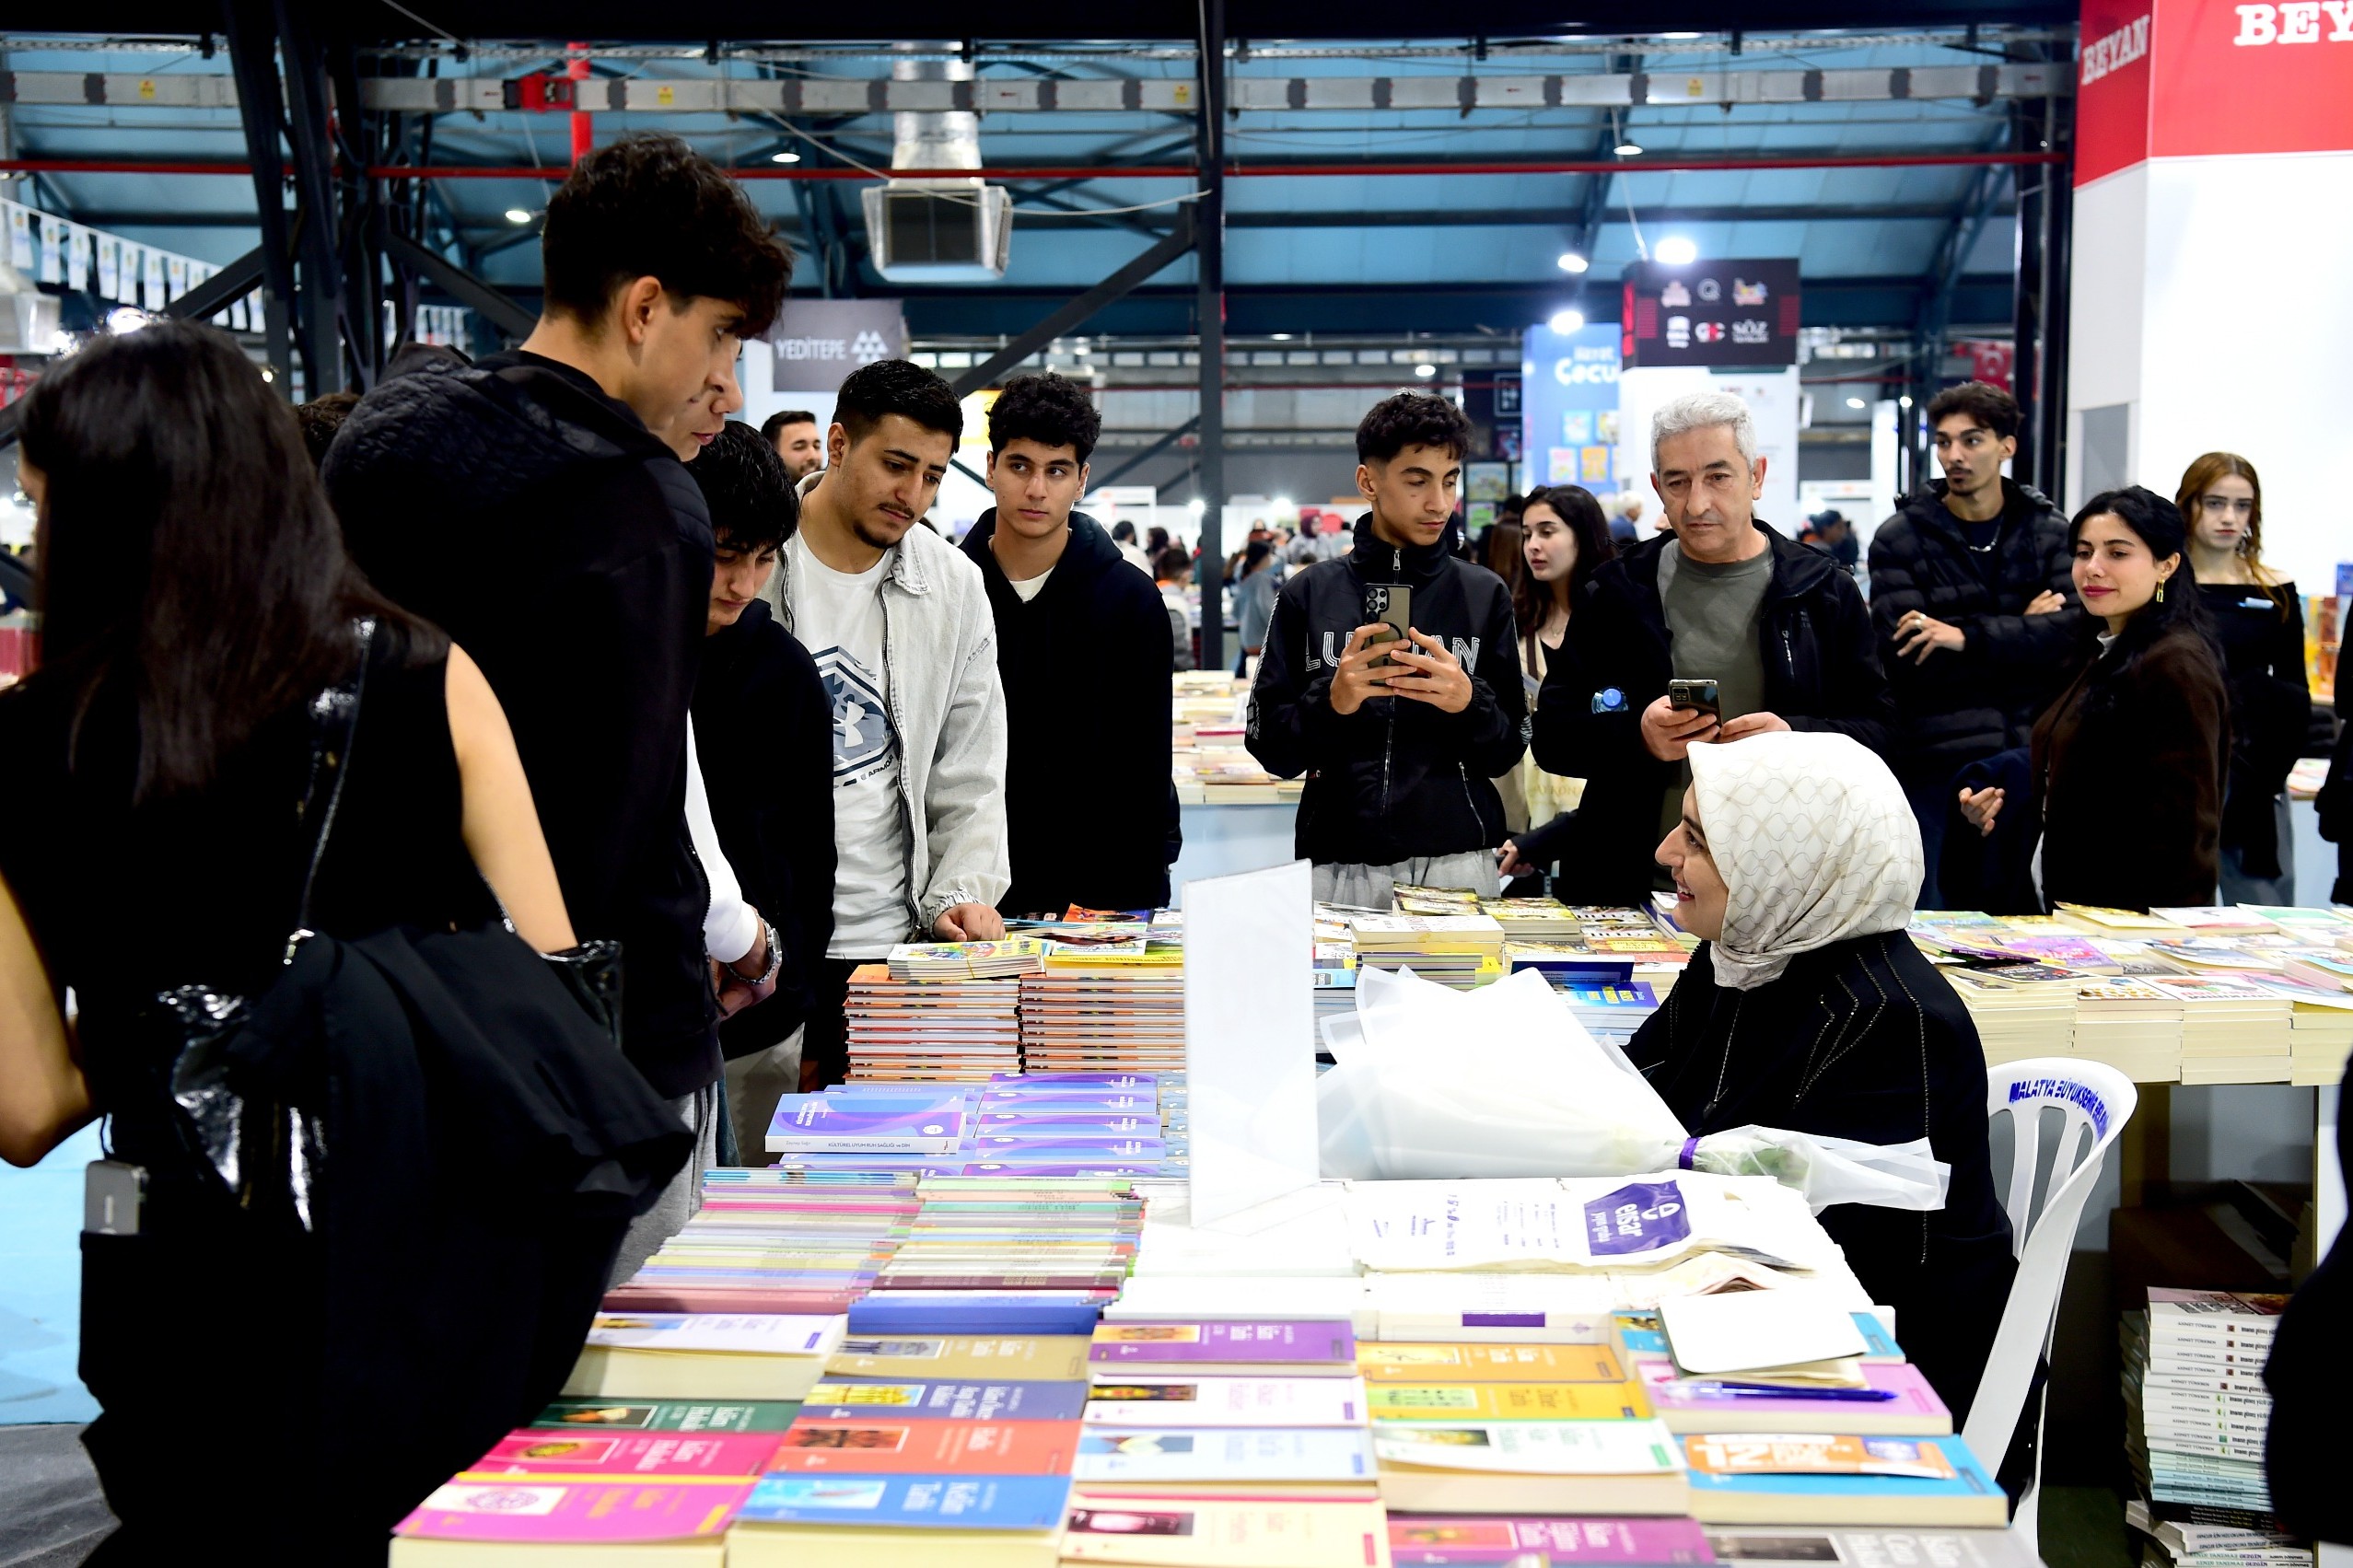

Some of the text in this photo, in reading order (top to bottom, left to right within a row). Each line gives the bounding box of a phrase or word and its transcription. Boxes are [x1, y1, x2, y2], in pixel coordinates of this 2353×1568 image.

[2081, 14, 2150, 86] BEYAN
[775, 336, 846, 360] YEDİTEPE
[2009, 1078, 2056, 1104] MALATYA
[1613, 1202, 1644, 1238] ensar
